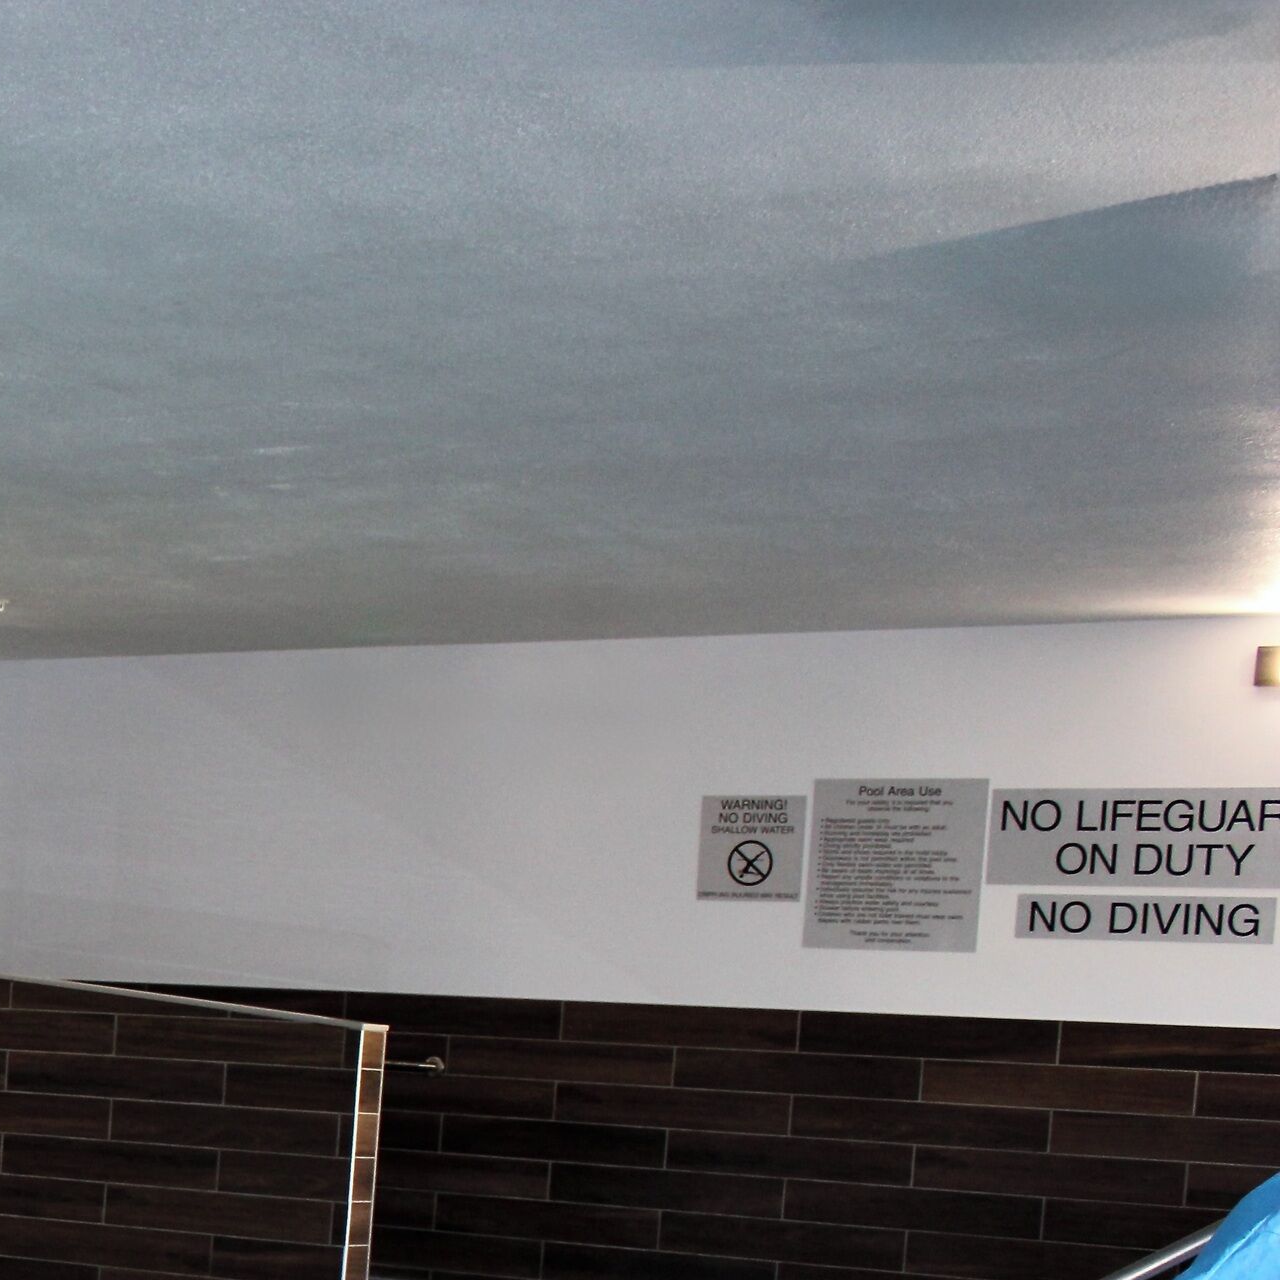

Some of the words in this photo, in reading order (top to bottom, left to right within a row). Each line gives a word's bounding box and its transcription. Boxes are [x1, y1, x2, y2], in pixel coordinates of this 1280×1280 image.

[858, 786, 885, 798] Pool
[888, 786, 915, 797] Area
[918, 786, 942, 797] Use
[721, 799, 788, 810] WARNING!
[718, 813, 739, 824] NO
[743, 812, 788, 824] DIVING
[1000, 799, 1062, 832] NO
[1076, 799, 1280, 832] LIFEGUAR
[711, 825, 757, 834] SHALLOW
[761, 826, 795, 834] WATER
[1056, 843, 1118, 875] ON
[1134, 843, 1256, 876] DUTY
[1028, 901, 1092, 934] NO
[1108, 902, 1260, 937] DIVING
